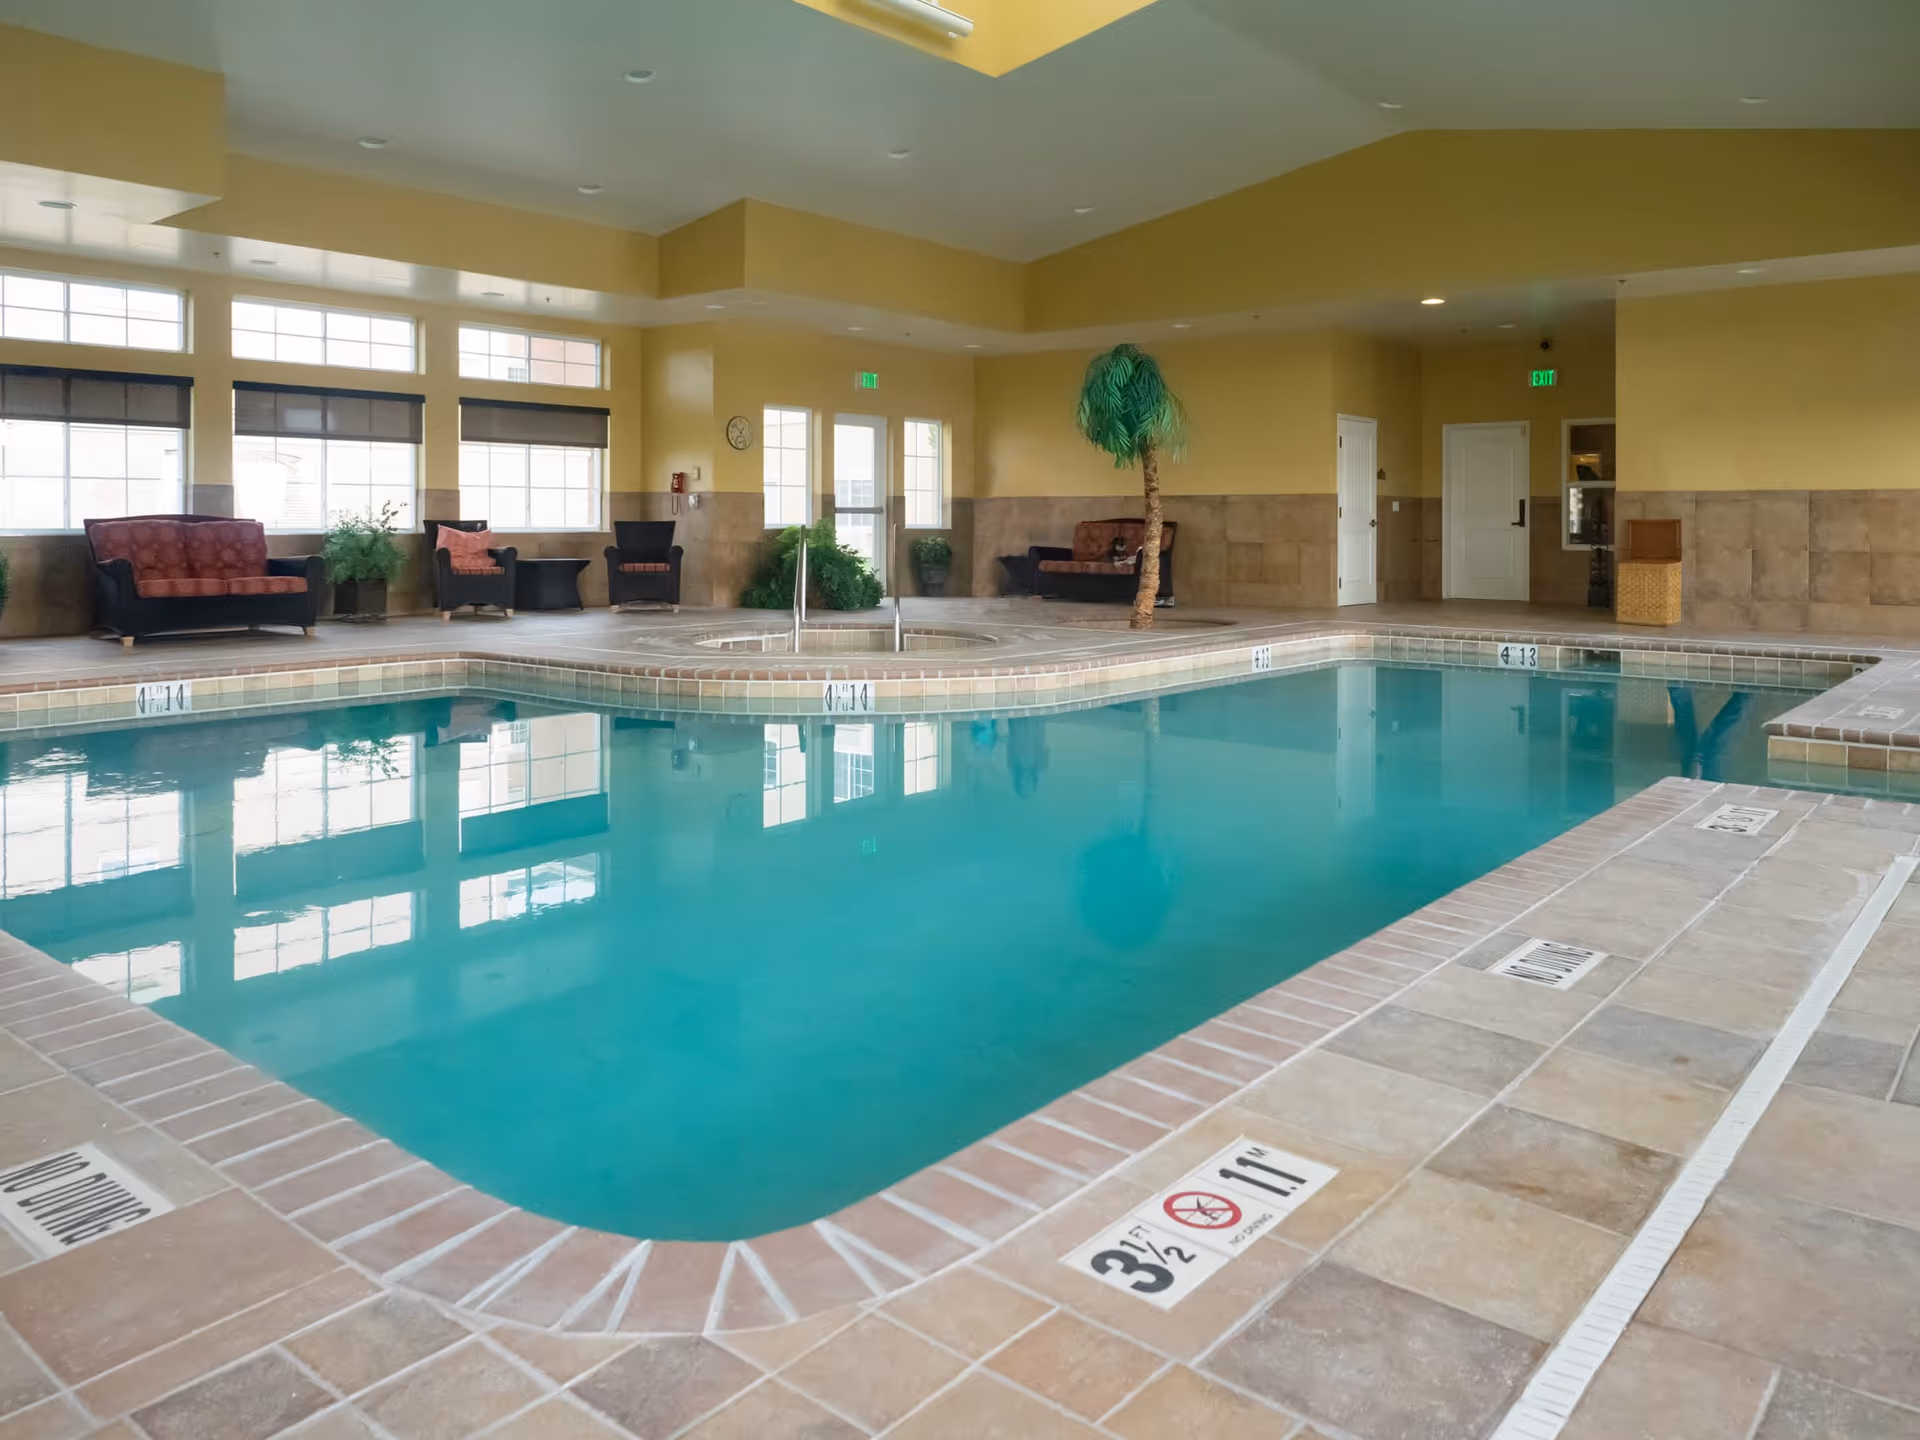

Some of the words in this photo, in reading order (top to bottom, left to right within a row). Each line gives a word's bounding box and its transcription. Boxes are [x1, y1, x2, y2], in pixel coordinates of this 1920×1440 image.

[1532, 370, 1554, 386] EXIT
[1518, 943, 1593, 973] DIVING
[1501, 965, 1563, 985] NO
[16, 1172, 151, 1246] DIVING
[1128, 1224, 1152, 1240] FT
[1228, 1234, 1246, 1246] NO
[1243, 1213, 1274, 1234] DIVING
